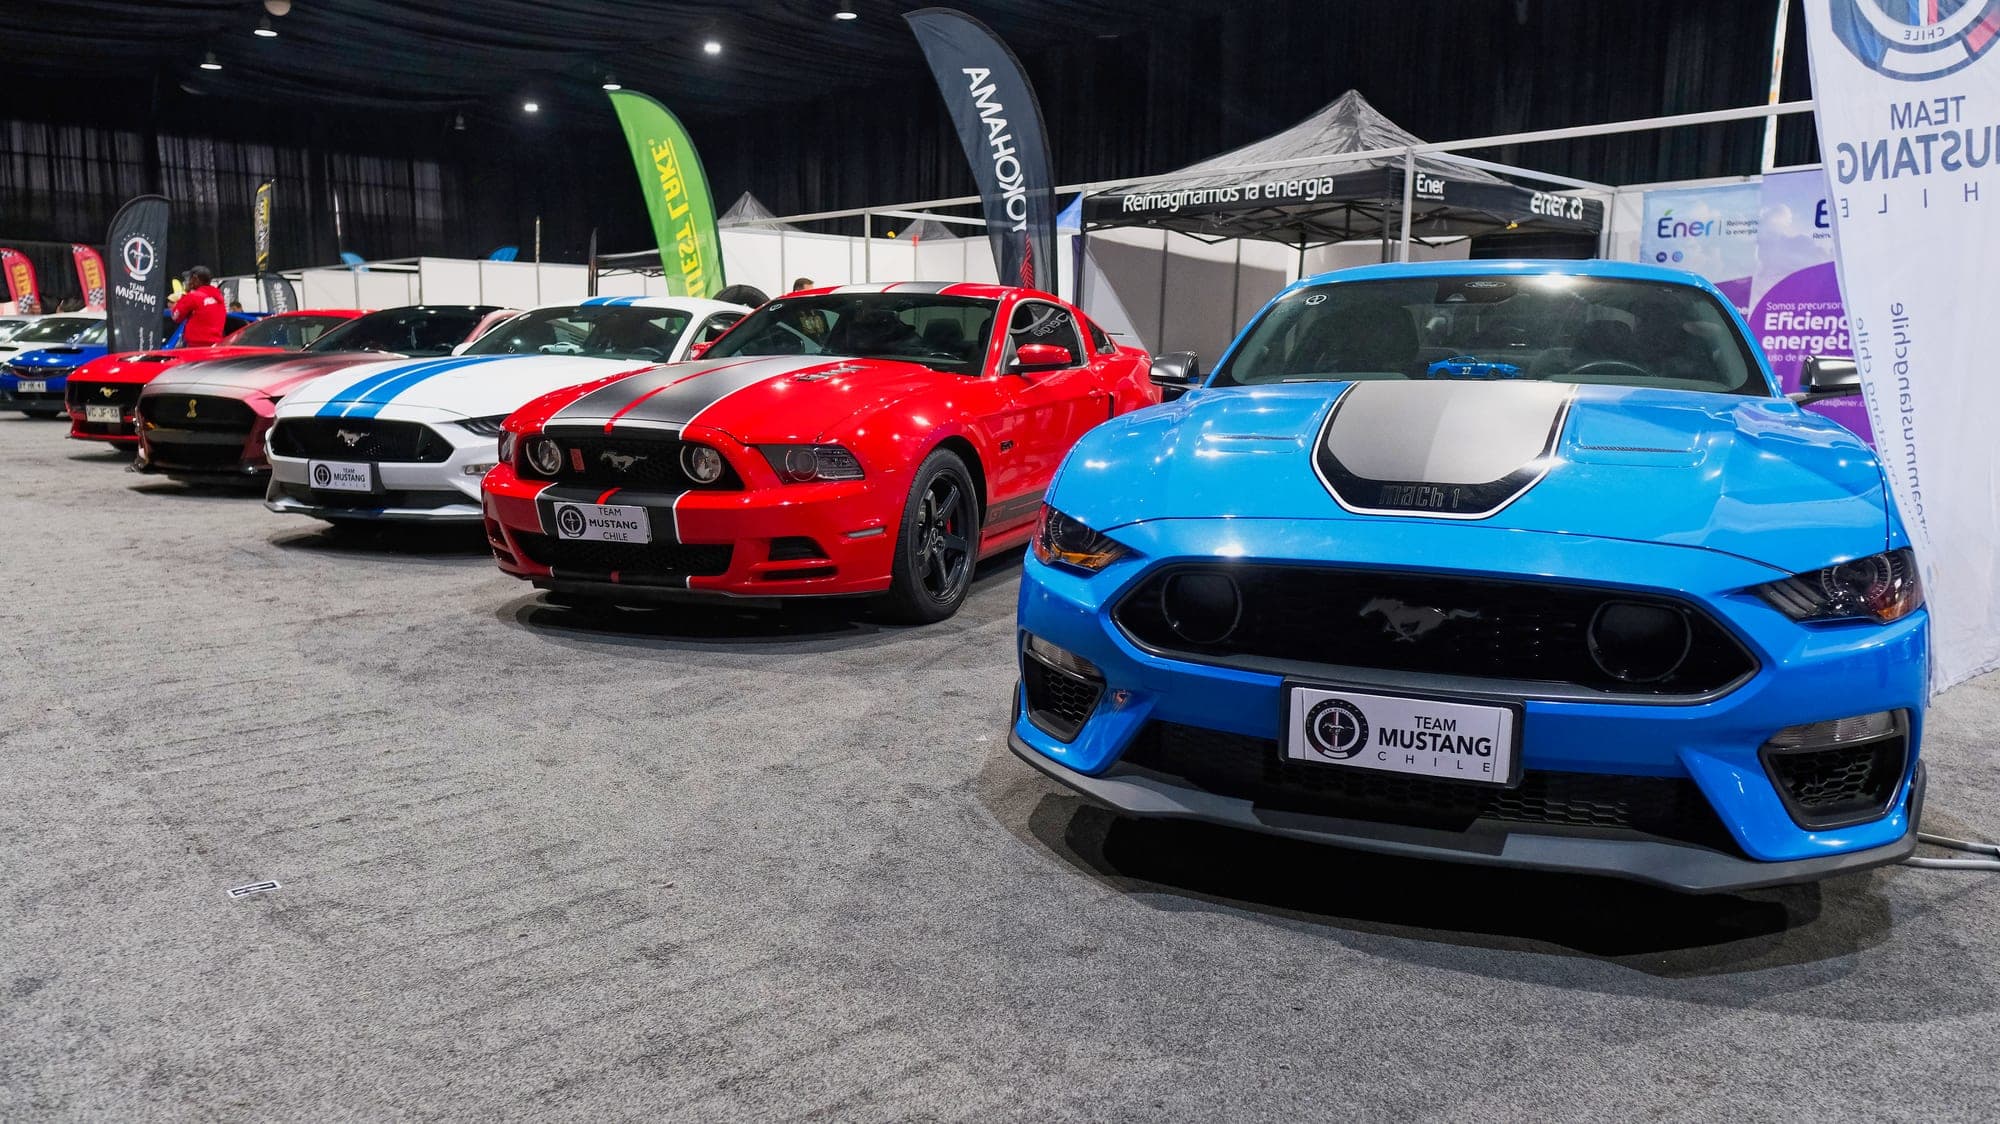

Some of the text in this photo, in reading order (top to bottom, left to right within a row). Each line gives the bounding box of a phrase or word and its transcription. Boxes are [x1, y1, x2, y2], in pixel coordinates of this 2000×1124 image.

[1122, 187, 1241, 213] Reimaginamos
[115, 284, 156, 306] MUSTANG
[1766, 302, 1796, 311] Somos
[1764, 311, 1849, 331] Eficienc
[1762, 331, 1852, 354] energét
[333, 472, 366, 482] MUSTANG
[598, 507, 622, 517] TEAM
[588, 518, 638, 530] MUSTANG
[602, 531, 628, 542] CHILE
[1414, 715, 1457, 733] TEAM
[1378, 727, 1492, 757] MUSTANG
[1377, 751, 1491, 773] CHILE
